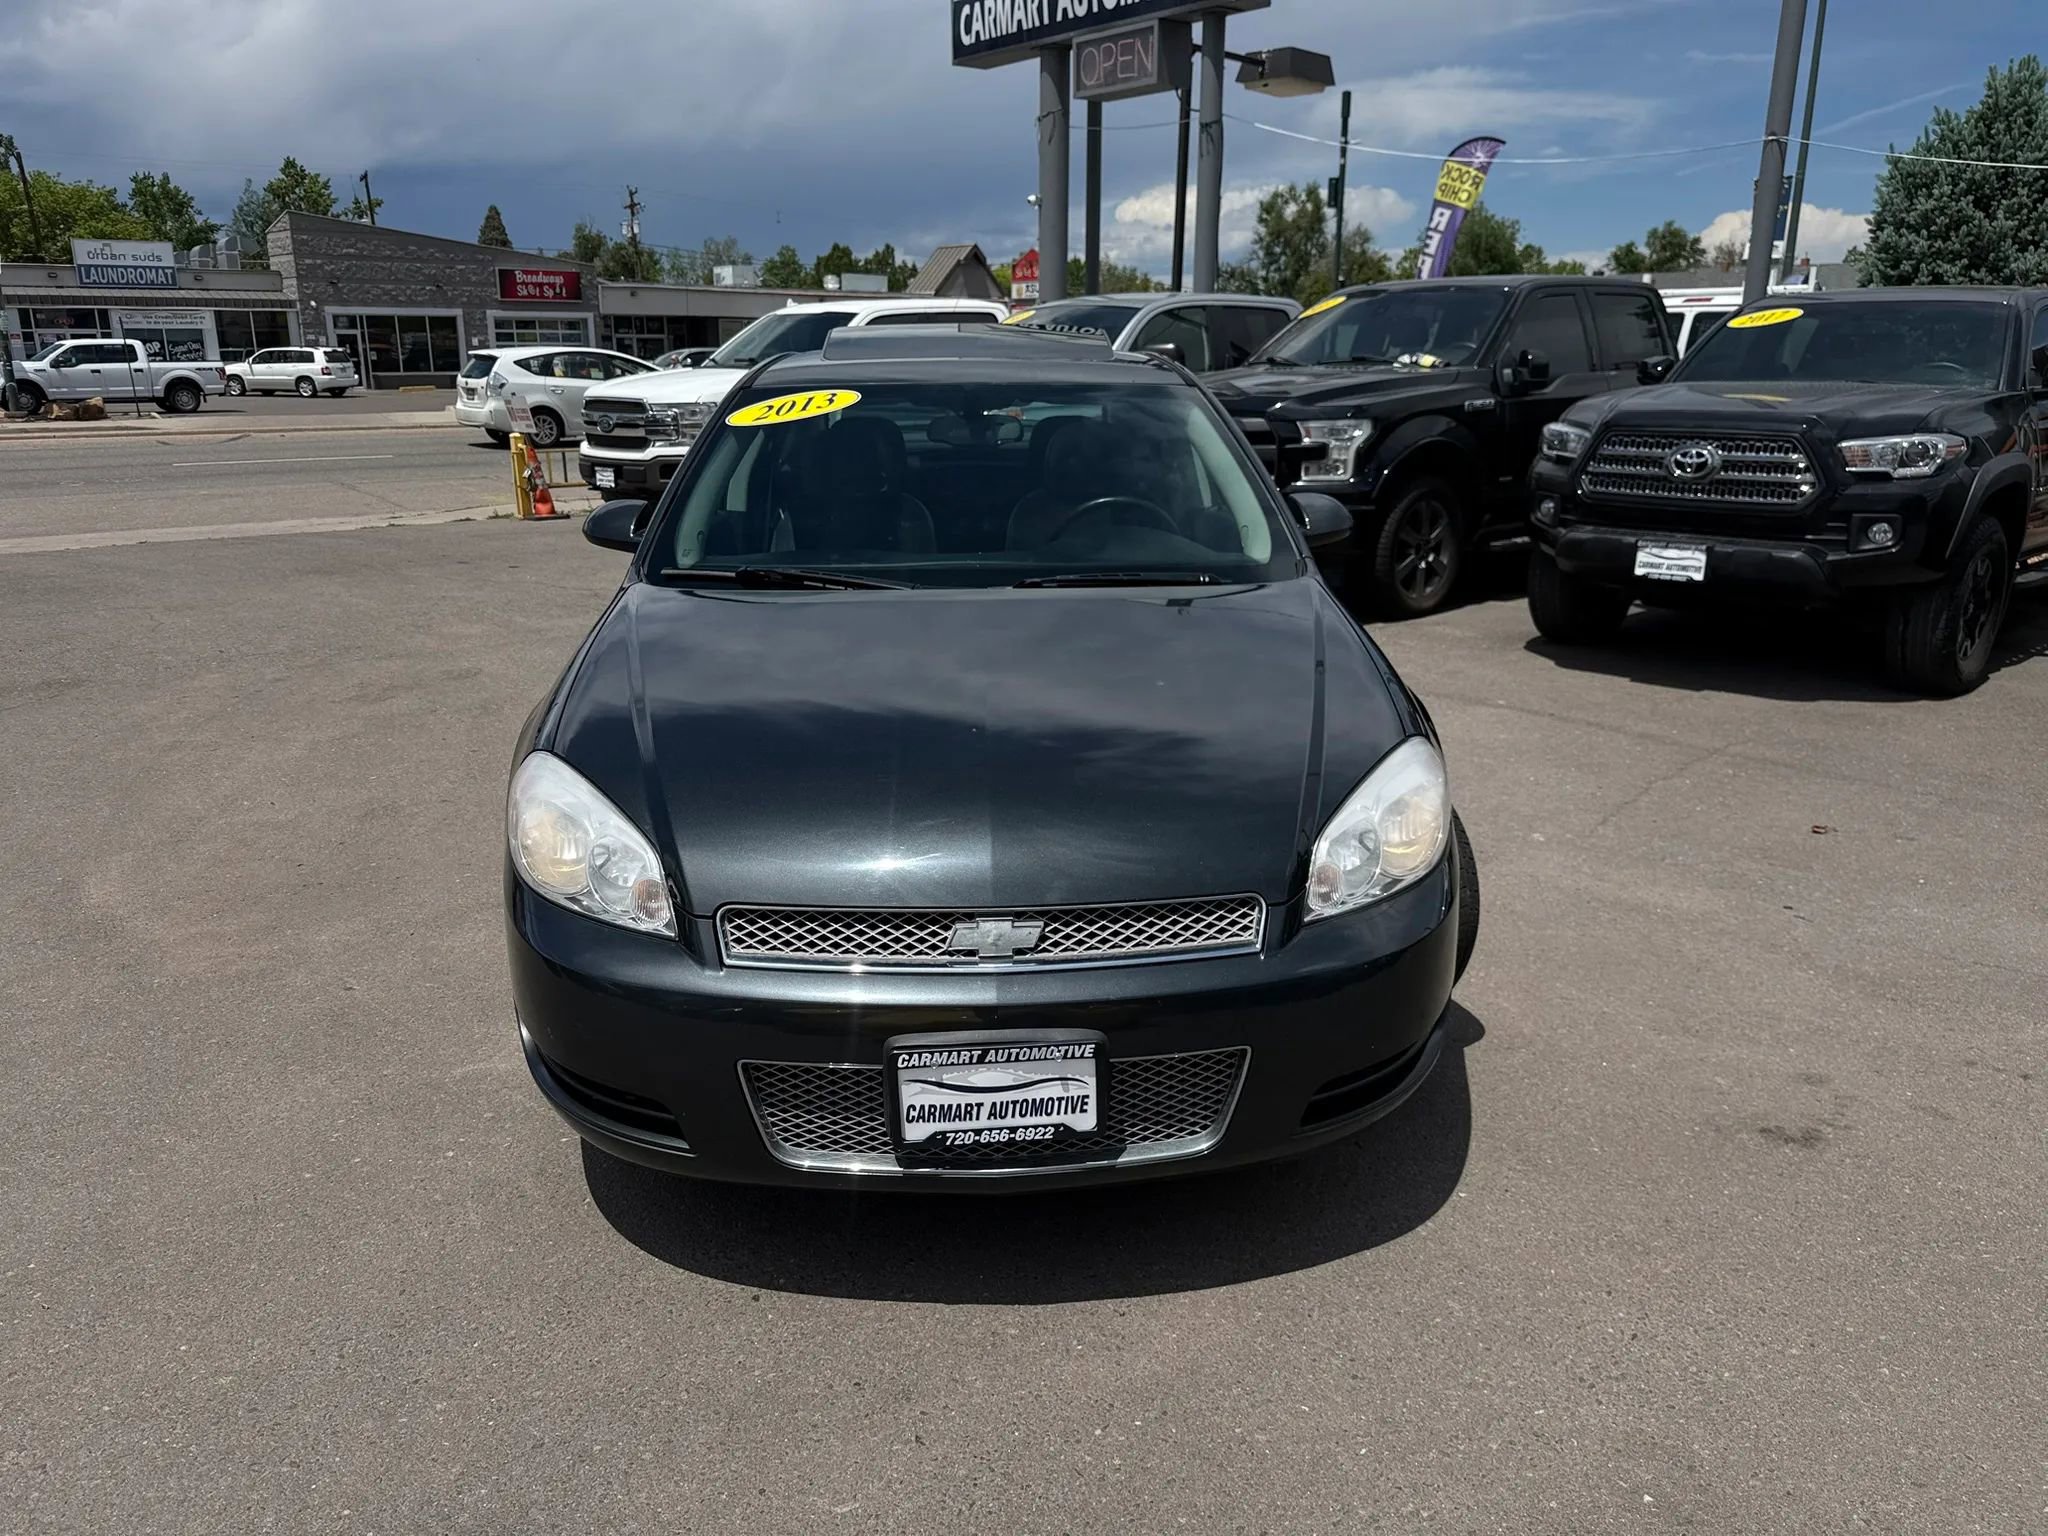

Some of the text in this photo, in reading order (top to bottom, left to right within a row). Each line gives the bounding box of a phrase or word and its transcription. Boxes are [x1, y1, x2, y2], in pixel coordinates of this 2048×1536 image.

[960, 0, 1049, 46] CARMART
[1080, 39, 1153, 86] OPEN
[132, 253, 162, 262] suds
[80, 267, 172, 284] LAUNDROMAT
[751, 392, 837, 422] 2013
[897, 1044, 1095, 1068] CARMART AUTOMOTIVE
[905, 1094, 1090, 1124] CARMART AUTOMOTIVE
[945, 1126, 1054, 1146] 720-656-6922
